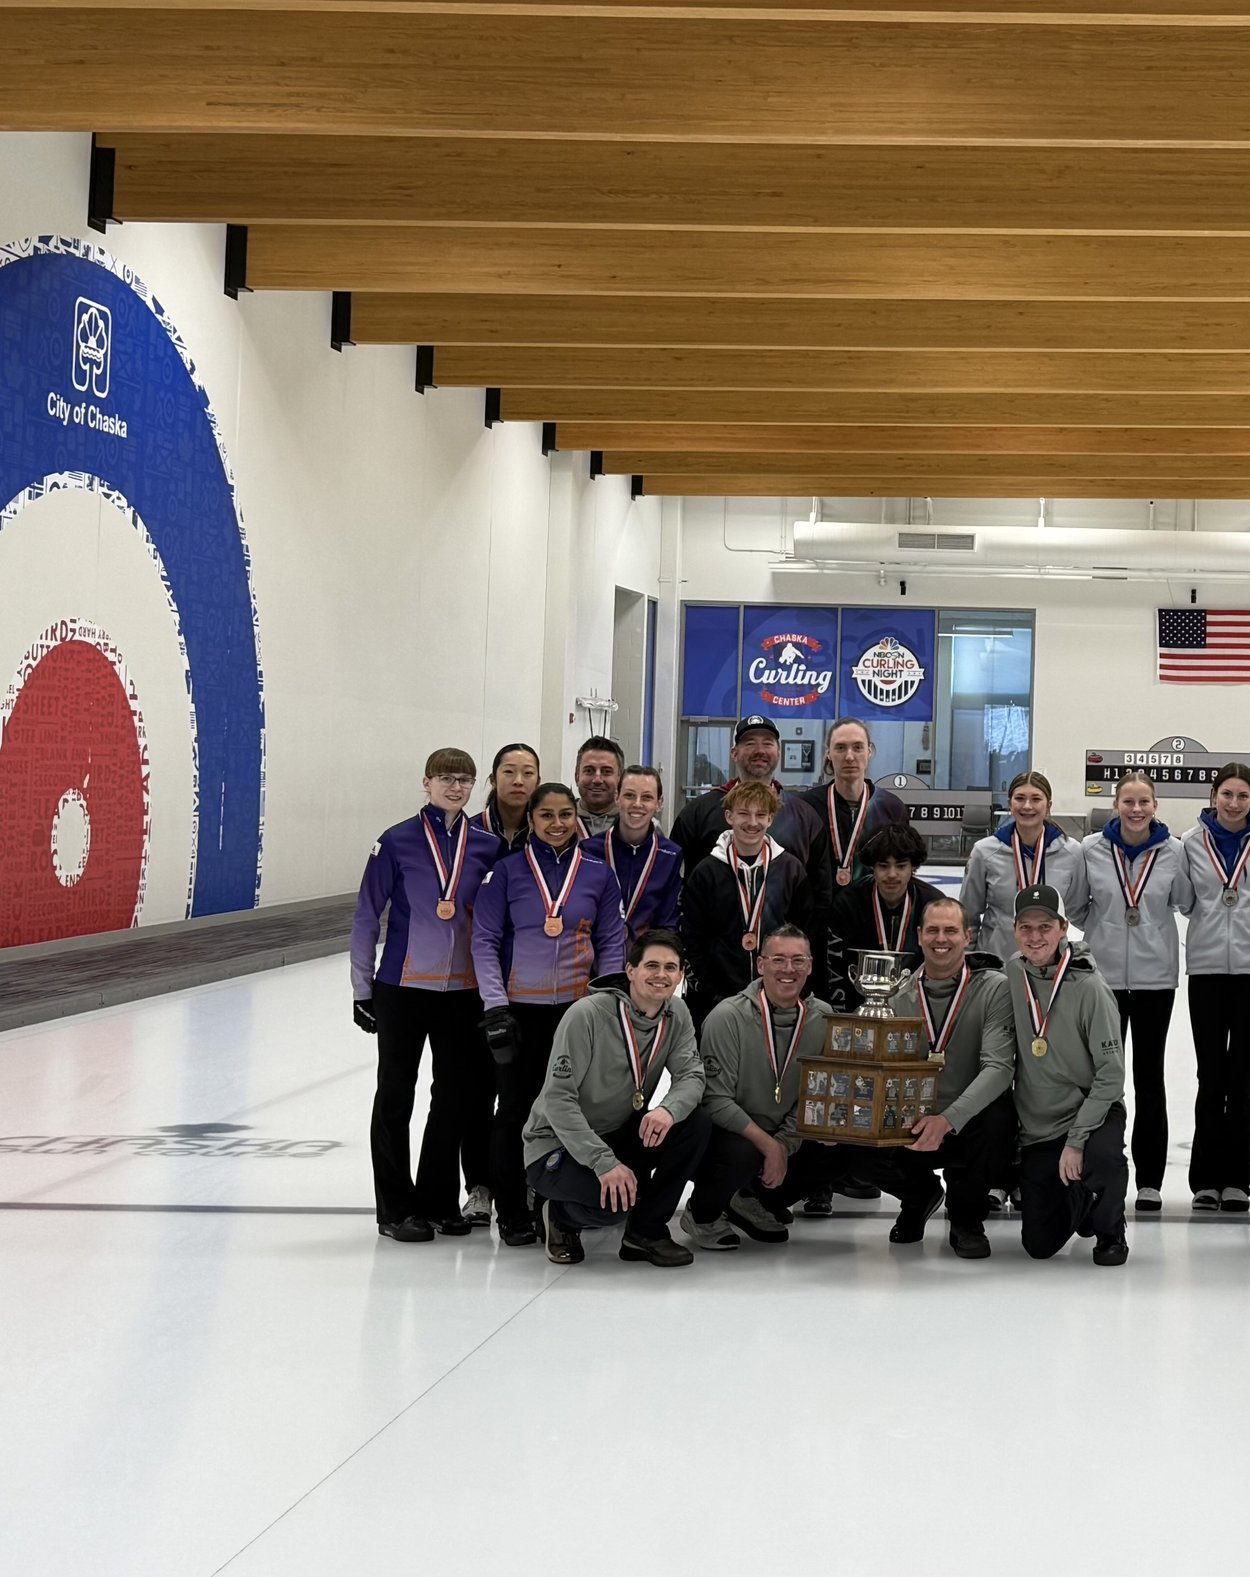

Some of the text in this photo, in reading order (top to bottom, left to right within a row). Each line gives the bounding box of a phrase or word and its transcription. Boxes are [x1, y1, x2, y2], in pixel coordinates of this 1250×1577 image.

[47, 392, 128, 438] City of Chaska
[773, 634, 808, 645] CHASKA
[862, 658, 915, 669] CURLING
[749, 657, 833, 694] Curling
[872, 669, 904, 679] NIGHT
[772, 696, 806, 706] CENTER
[1126, 755, 1181, 764] 3 4 5 7 8
[1104, 768, 1110, 778] H
[1113, 768, 1120, 778] 1
[1150, 769, 1157, 780] 4
[1162, 769, 1169, 780] 5
[1174, 770, 1181, 780] 6
[1187, 770, 1194, 781] 7
[1199, 770, 1206, 781] 8
[909, 807, 915, 818] 7
[921, 807, 928, 818] 8
[933, 807, 940, 818] 9
[943, 807, 955, 818] 10
[0, 1136, 345, 1152] CHASKA
[0, 1147, 326, 1158] own course
